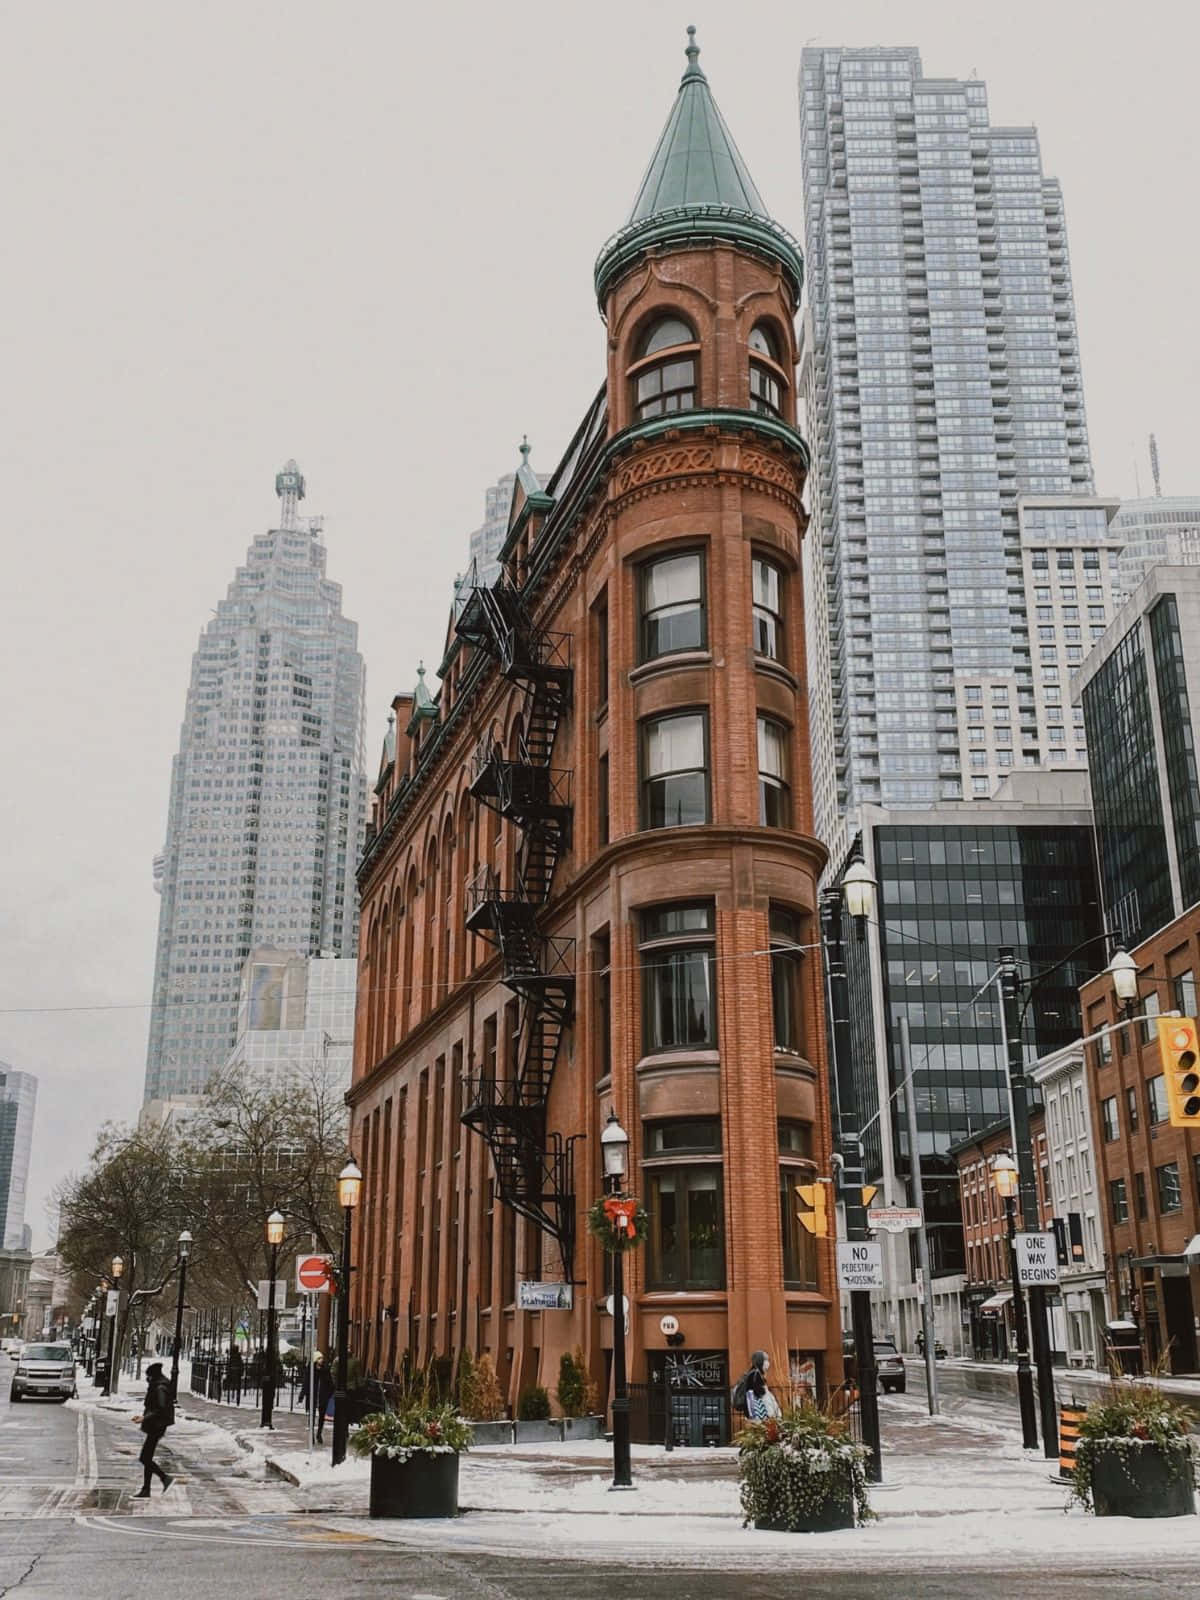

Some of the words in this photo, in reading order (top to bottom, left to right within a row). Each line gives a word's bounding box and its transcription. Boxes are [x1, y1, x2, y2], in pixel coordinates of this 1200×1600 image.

[1025, 1237, 1046, 1249] ONE
[852, 1247, 868, 1260] NO
[1027, 1253, 1046, 1265] WAY
[1020, 1268, 1057, 1281] BEGINS
[699, 1361, 720, 1369] THE
